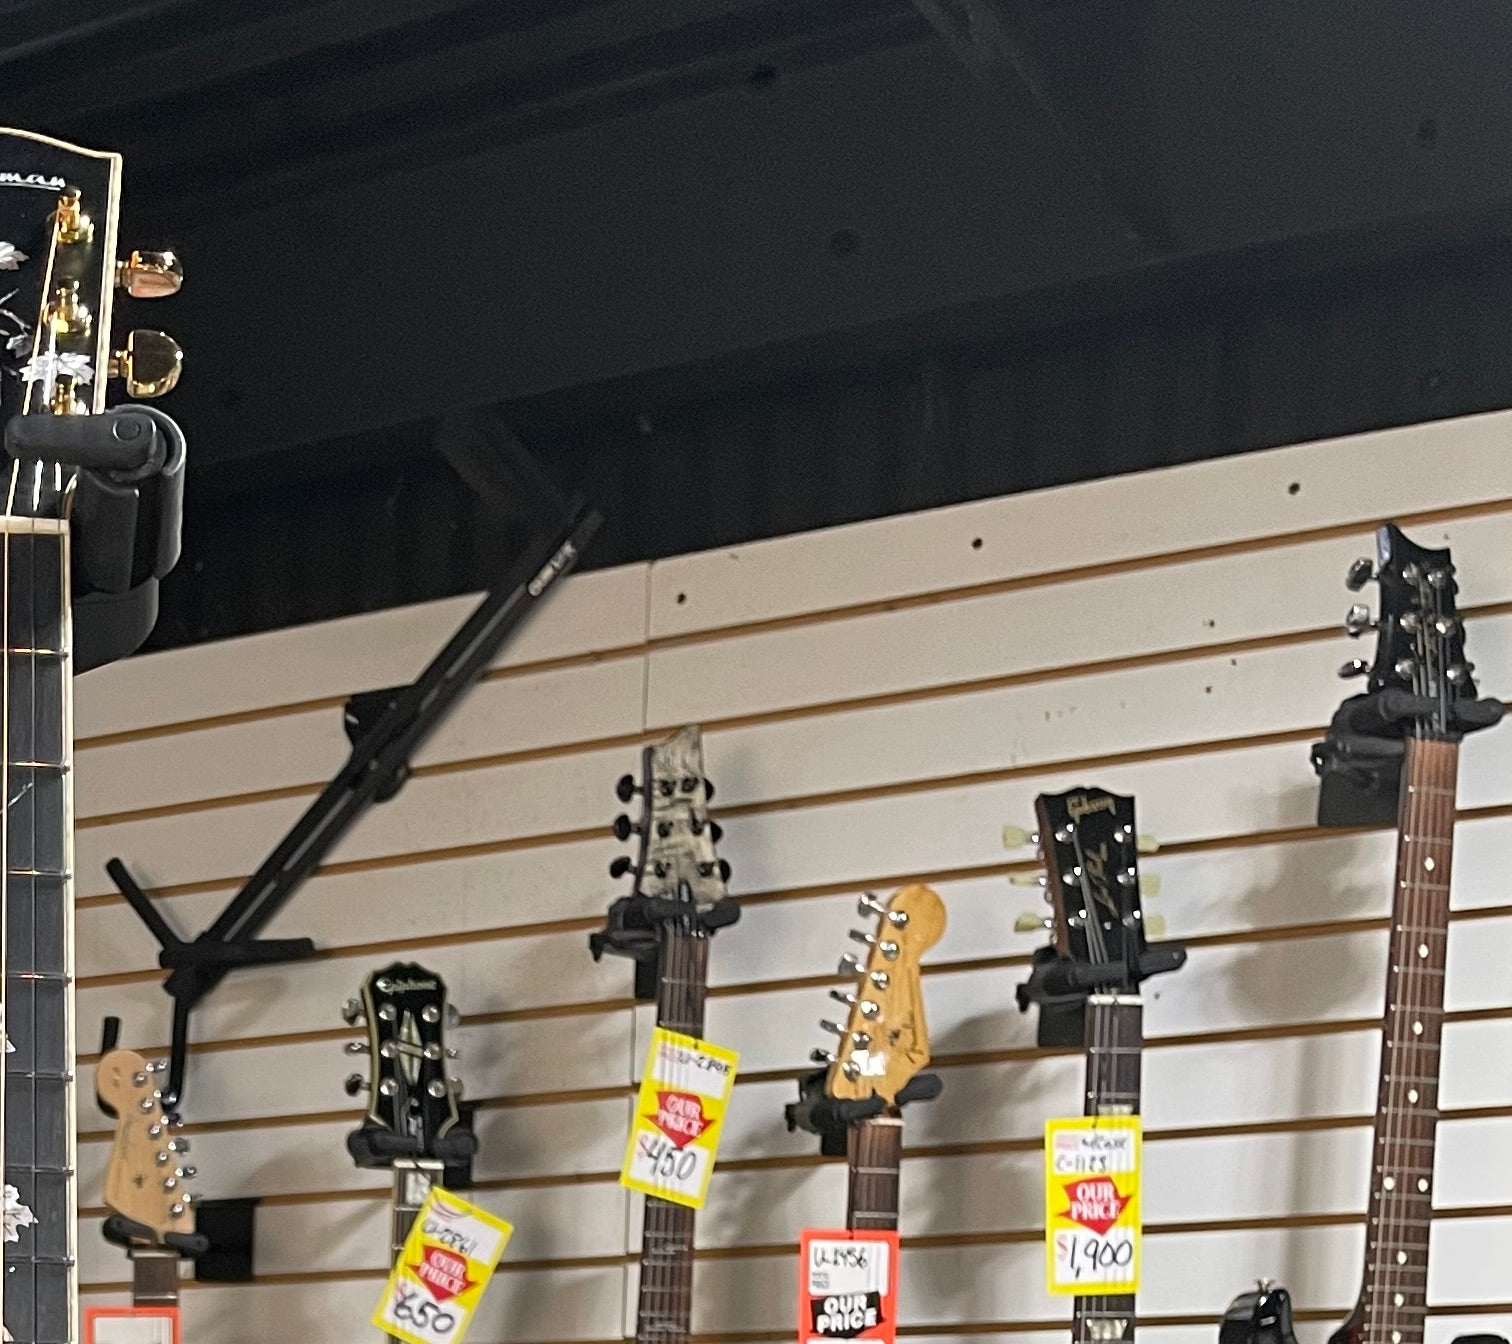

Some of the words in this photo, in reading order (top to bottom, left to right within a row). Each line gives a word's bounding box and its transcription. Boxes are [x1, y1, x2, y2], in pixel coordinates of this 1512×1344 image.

[665, 1093, 703, 1121] OUR
[658, 1110, 704, 1137] PRICE
[1076, 1182, 1114, 1201] OUR
[1071, 1199, 1122, 1222] PRICE
[430, 1250, 467, 1280] OUR
[1057, 1233, 1133, 1279] $1,900
[418, 1263, 467, 1296] PRICE
[823, 1294, 868, 1315] OUR
[817, 1308, 878, 1335] PRICE
